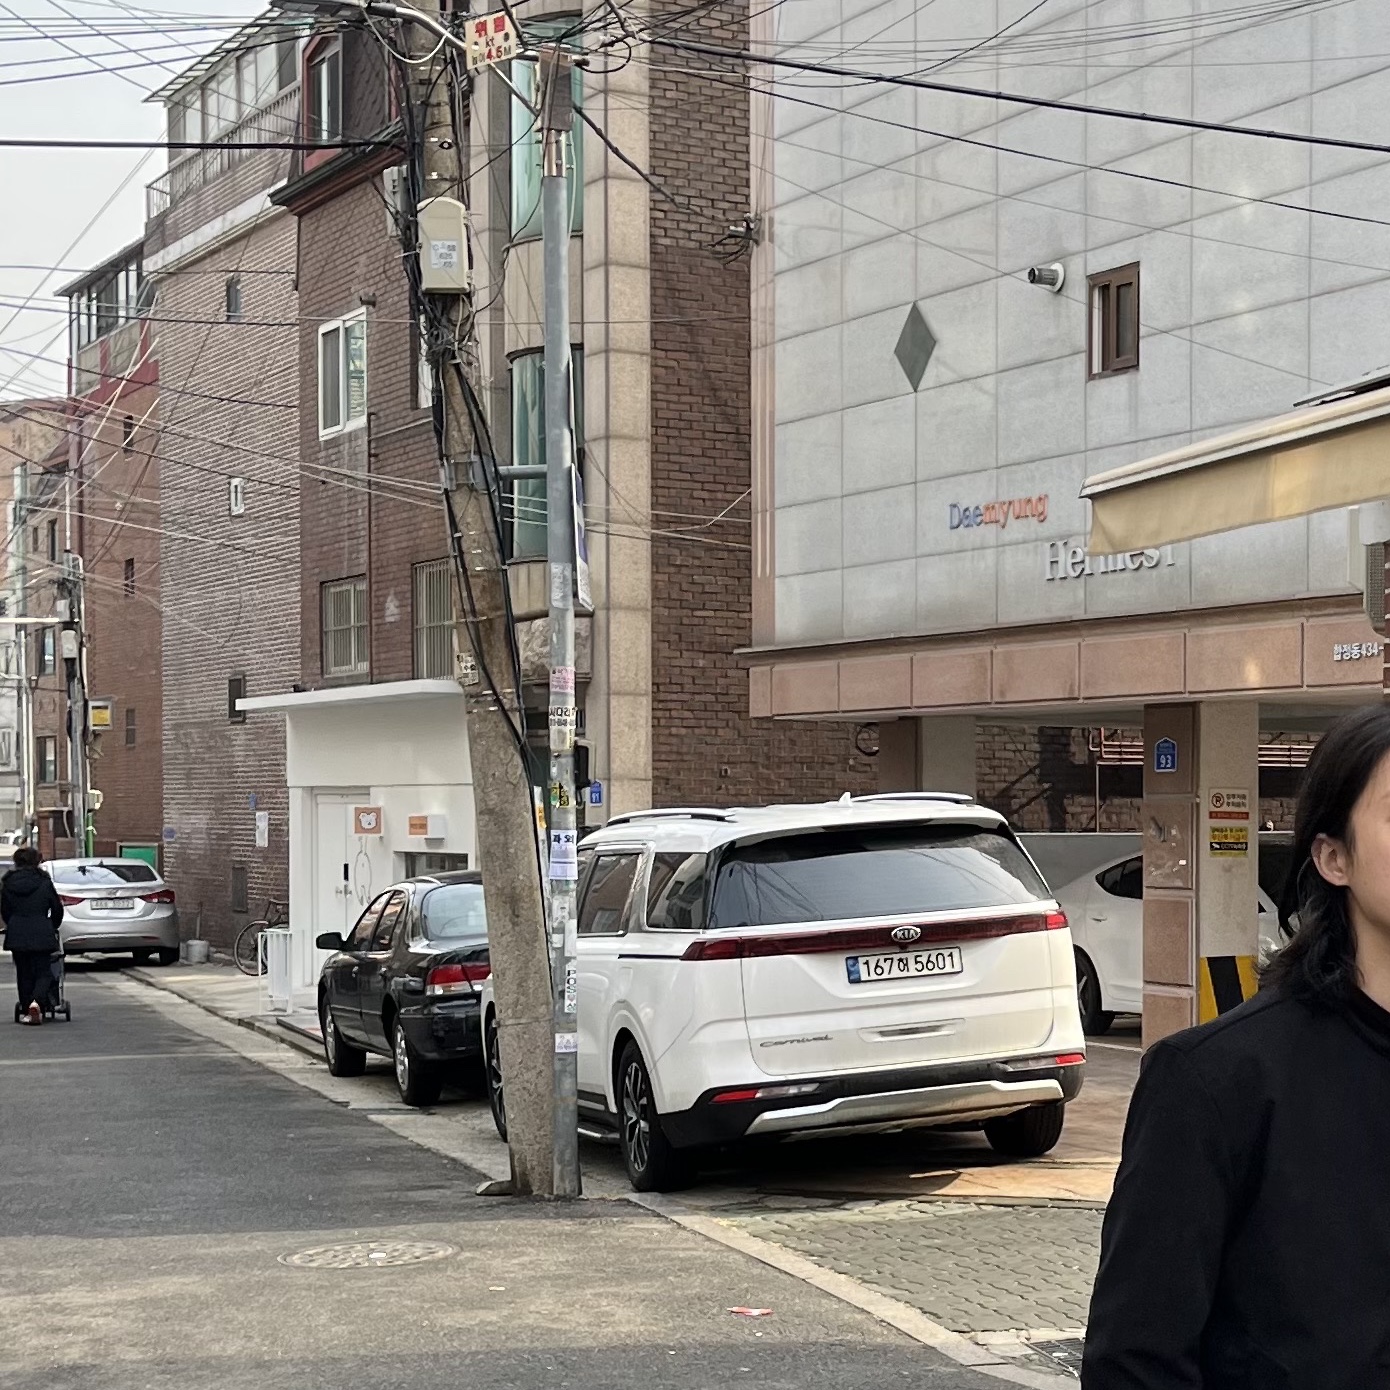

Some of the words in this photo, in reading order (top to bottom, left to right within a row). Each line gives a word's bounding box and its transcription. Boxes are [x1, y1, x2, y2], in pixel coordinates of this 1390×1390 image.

[486, 36, 495, 48] kt
[949, 493, 1049, 530] Daemyung
[1160, 754, 1171, 768] 93
[896, 929, 917, 939] KIA
[914, 951, 955, 973] 5601
